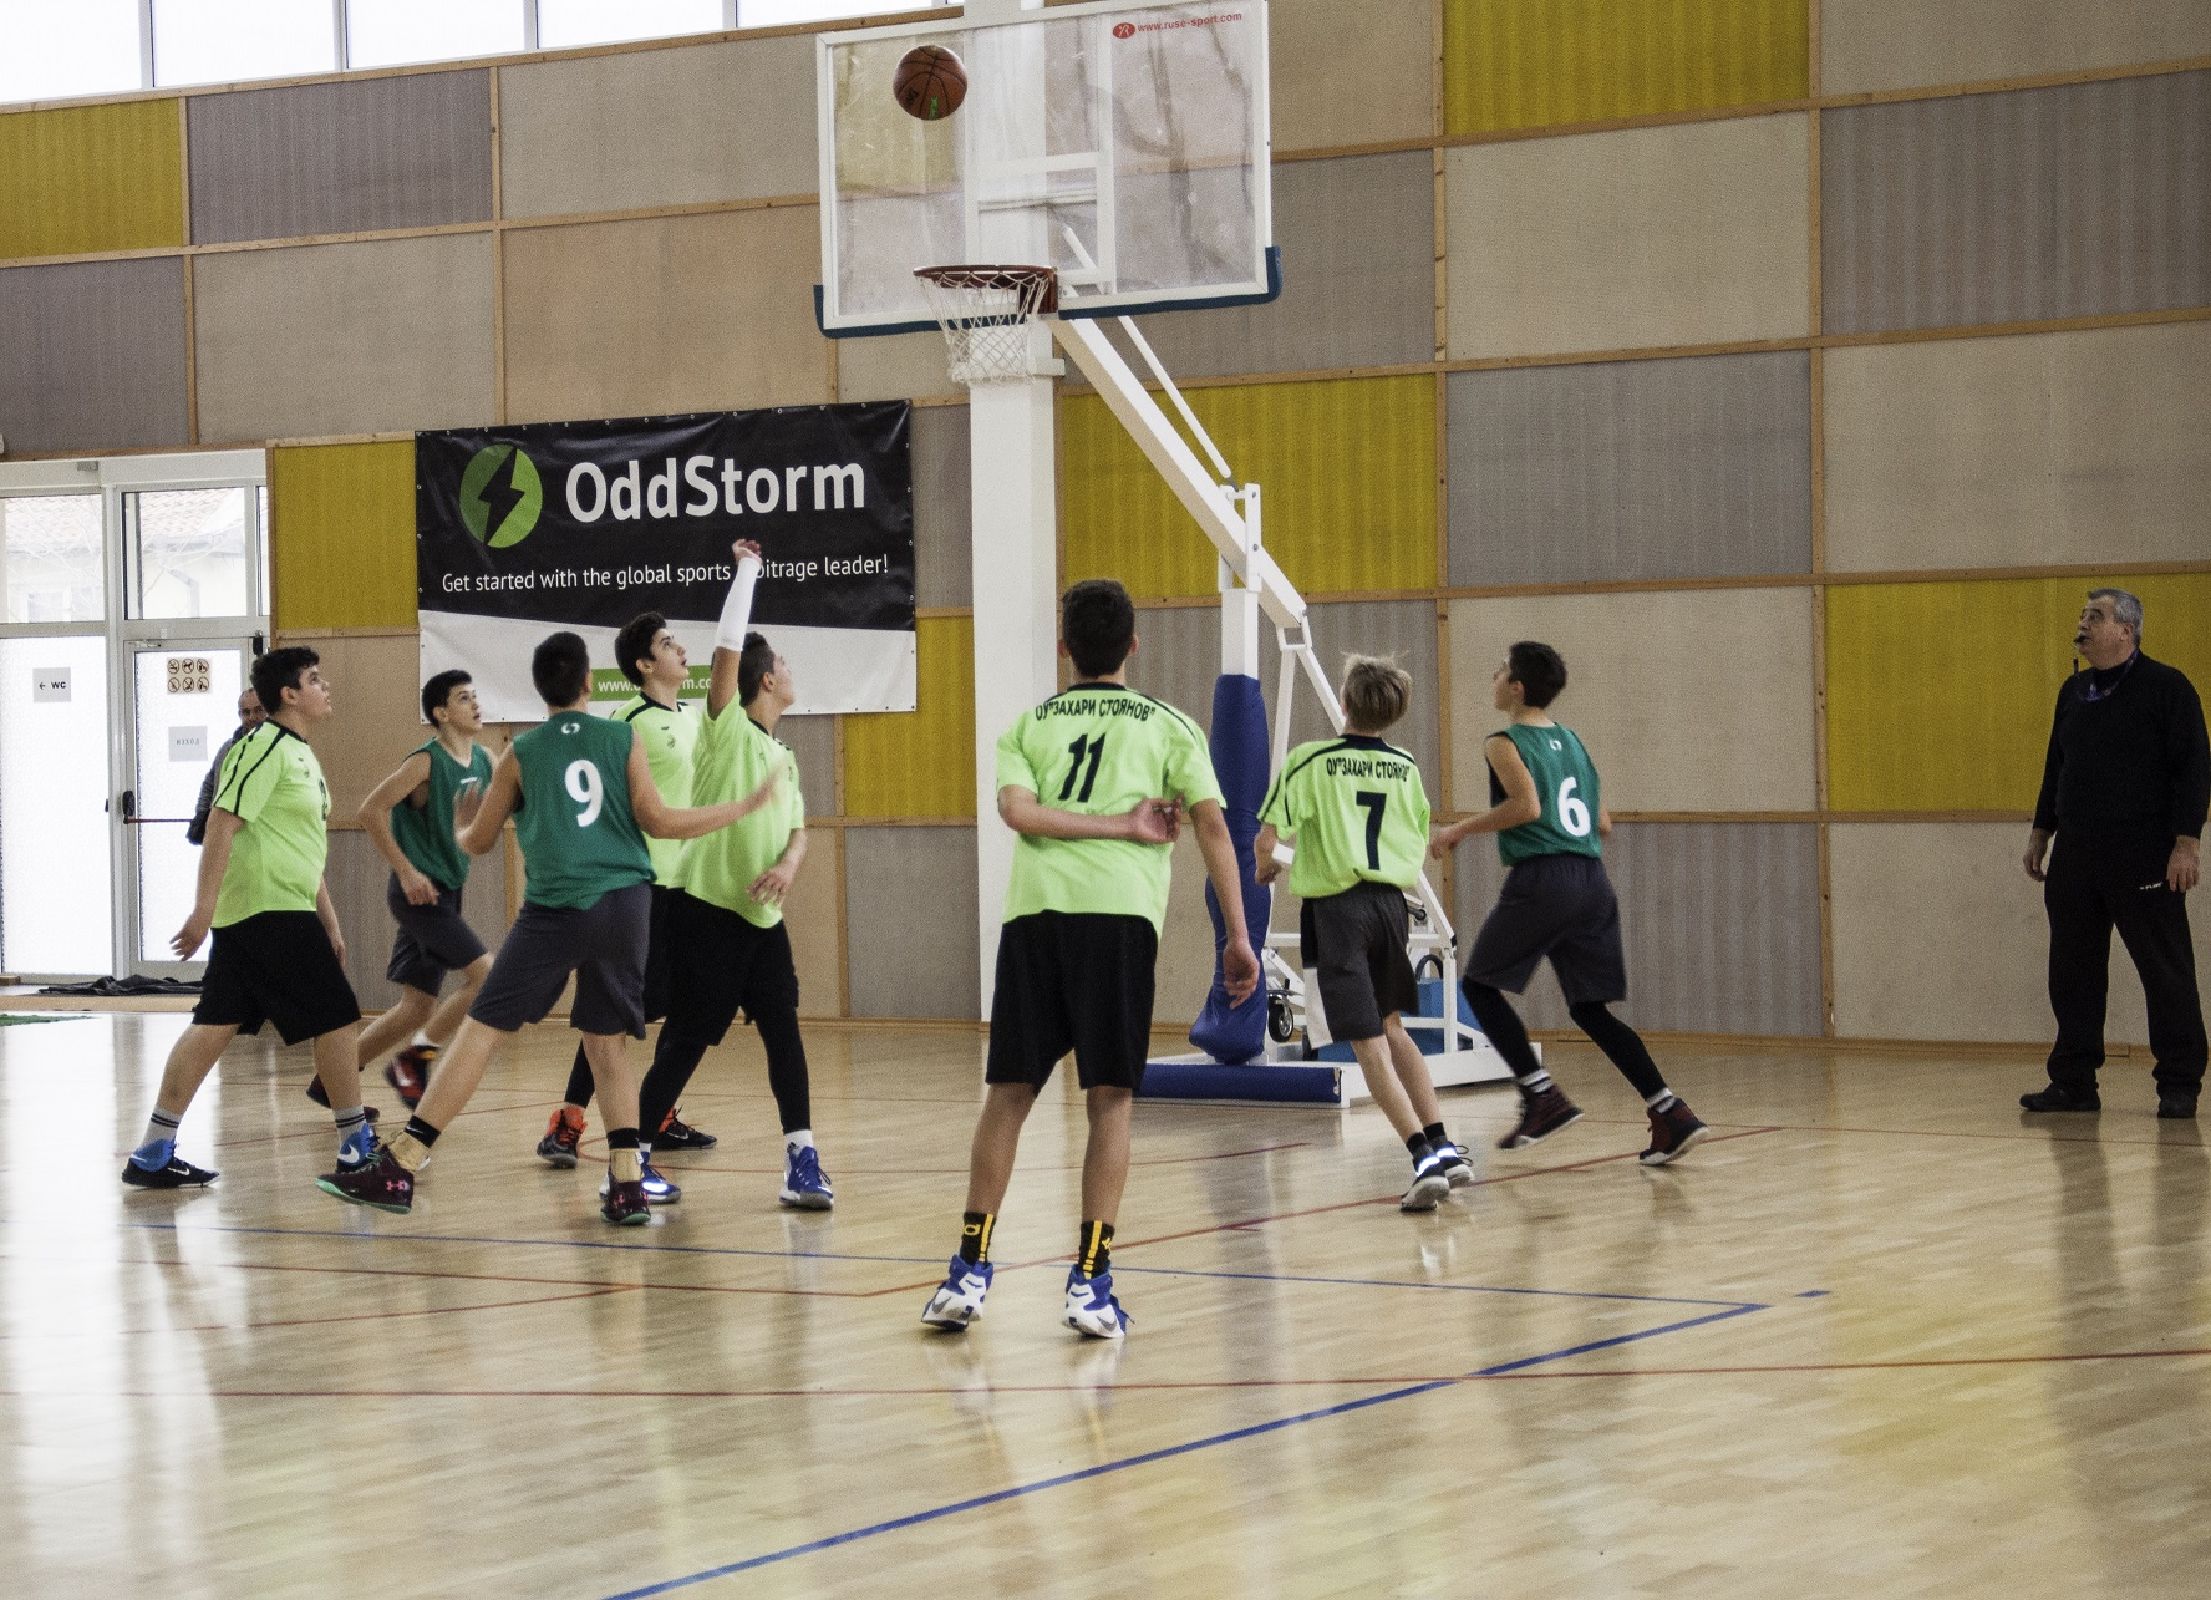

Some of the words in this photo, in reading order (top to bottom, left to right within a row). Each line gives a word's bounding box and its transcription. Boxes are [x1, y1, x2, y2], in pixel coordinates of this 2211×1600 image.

[1137, 13, 1242, 31] www.ruse-sport.com
[565, 455, 865, 523] OddStorm
[442, 573, 470, 592] Get
[475, 570, 535, 591] started
[539, 568, 577, 588] with
[583, 567, 611, 586] the
[616, 563, 672, 590] global
[676, 563, 731, 587] sports
[824, 553, 889, 576] leader!
[565, 760, 604, 827] 9
[1057, 732, 1106, 803] 11
[1356, 791, 1387, 871] 7
[1558, 776, 1591, 837] 6
